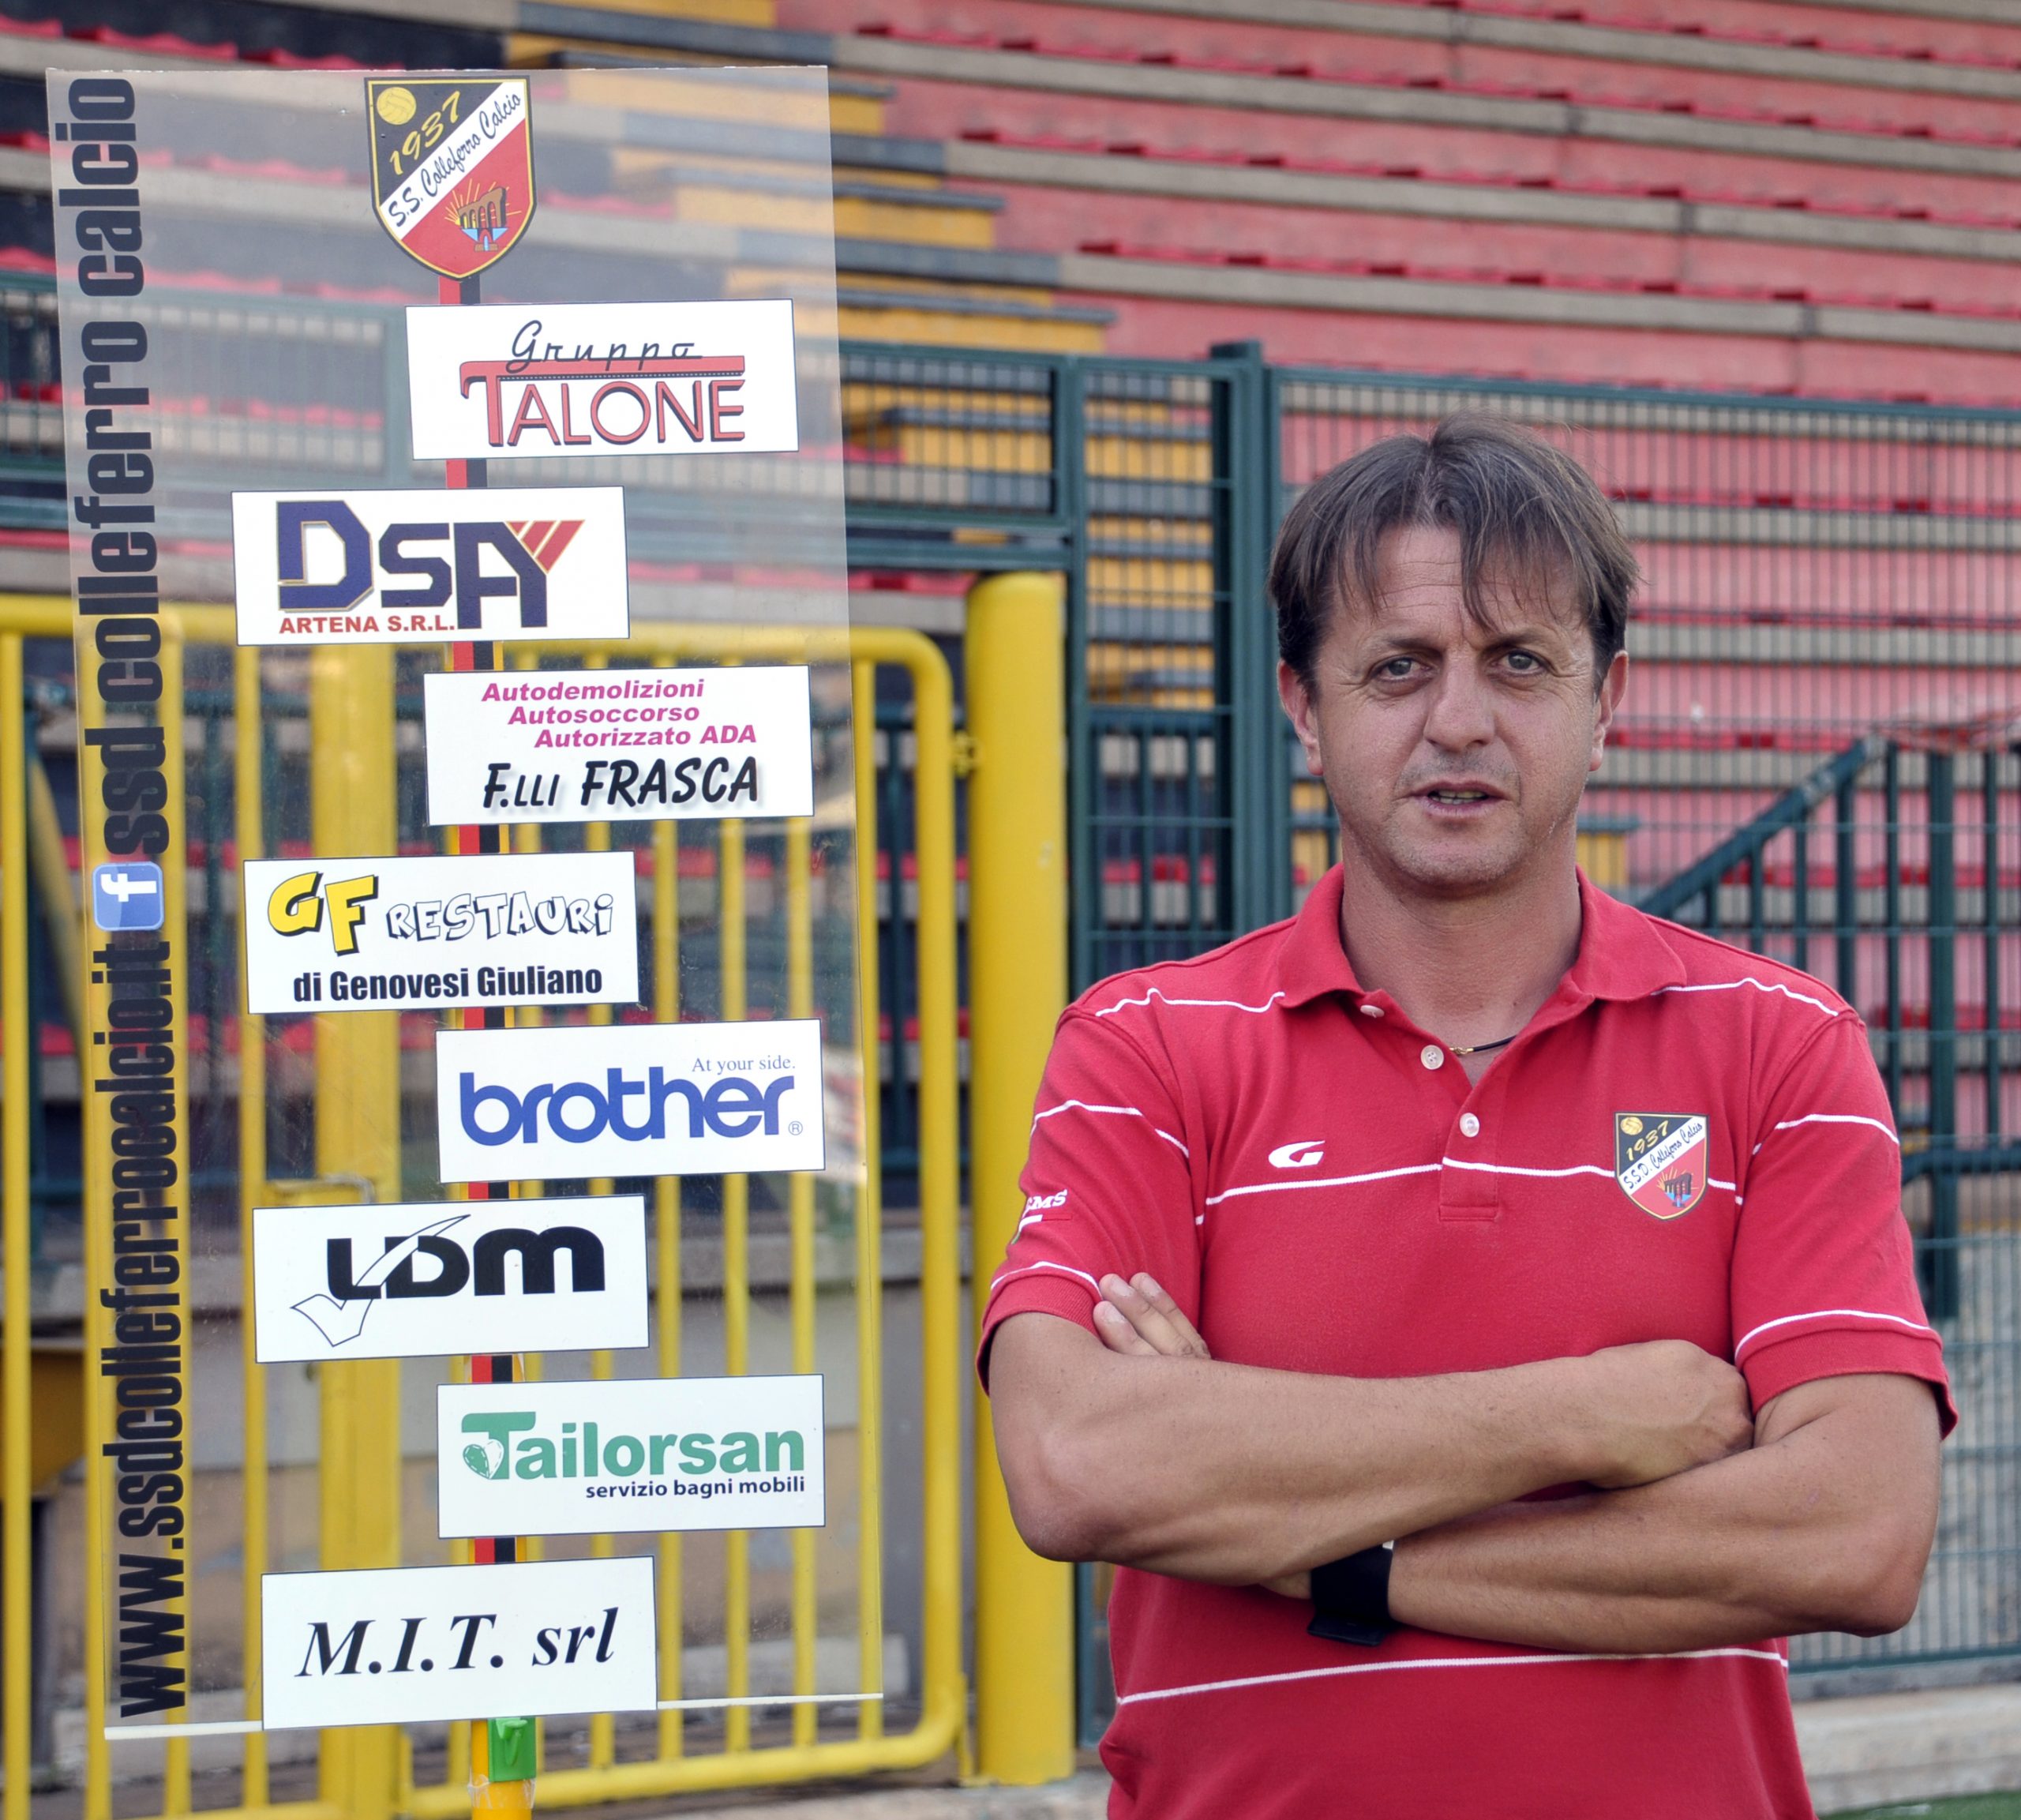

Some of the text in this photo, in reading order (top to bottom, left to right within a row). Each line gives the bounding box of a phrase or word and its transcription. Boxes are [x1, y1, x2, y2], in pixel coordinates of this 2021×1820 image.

[388, 92, 521, 228] S.S. Colleferro Calcio
[389, 91, 461, 175] 1937
[54, 78, 144, 297] calcio
[505, 319, 703, 373] Gruppo
[459, 355, 746, 447] TALONE
[73, 321, 163, 702] colleferro
[279, 614, 456, 634] ARTENA S.R.L.
[481, 678, 705, 703] Autodemolizioni
[507, 705, 700, 726] Autosoccorso
[534, 724, 757, 749] Autorizzato ADA
[84, 726, 170, 855] ssd
[579, 756, 759, 808] FRASCA
[267, 870, 379, 957] GF
[293, 965, 603, 1001] di Genovesi Giuliano
[691, 1054, 797, 1076] At your side.
[459, 1067, 795, 1146] brother
[1626, 1120, 1669, 1161] 1937
[91, 940, 186, 1719] www.ssdcolleferrocalcio.it
[460, 1411, 804, 1480] Tailorsan
[585, 1476, 805, 1499] servizio bagni mobili
[294, 1606, 620, 1678] M.I.T. srl
